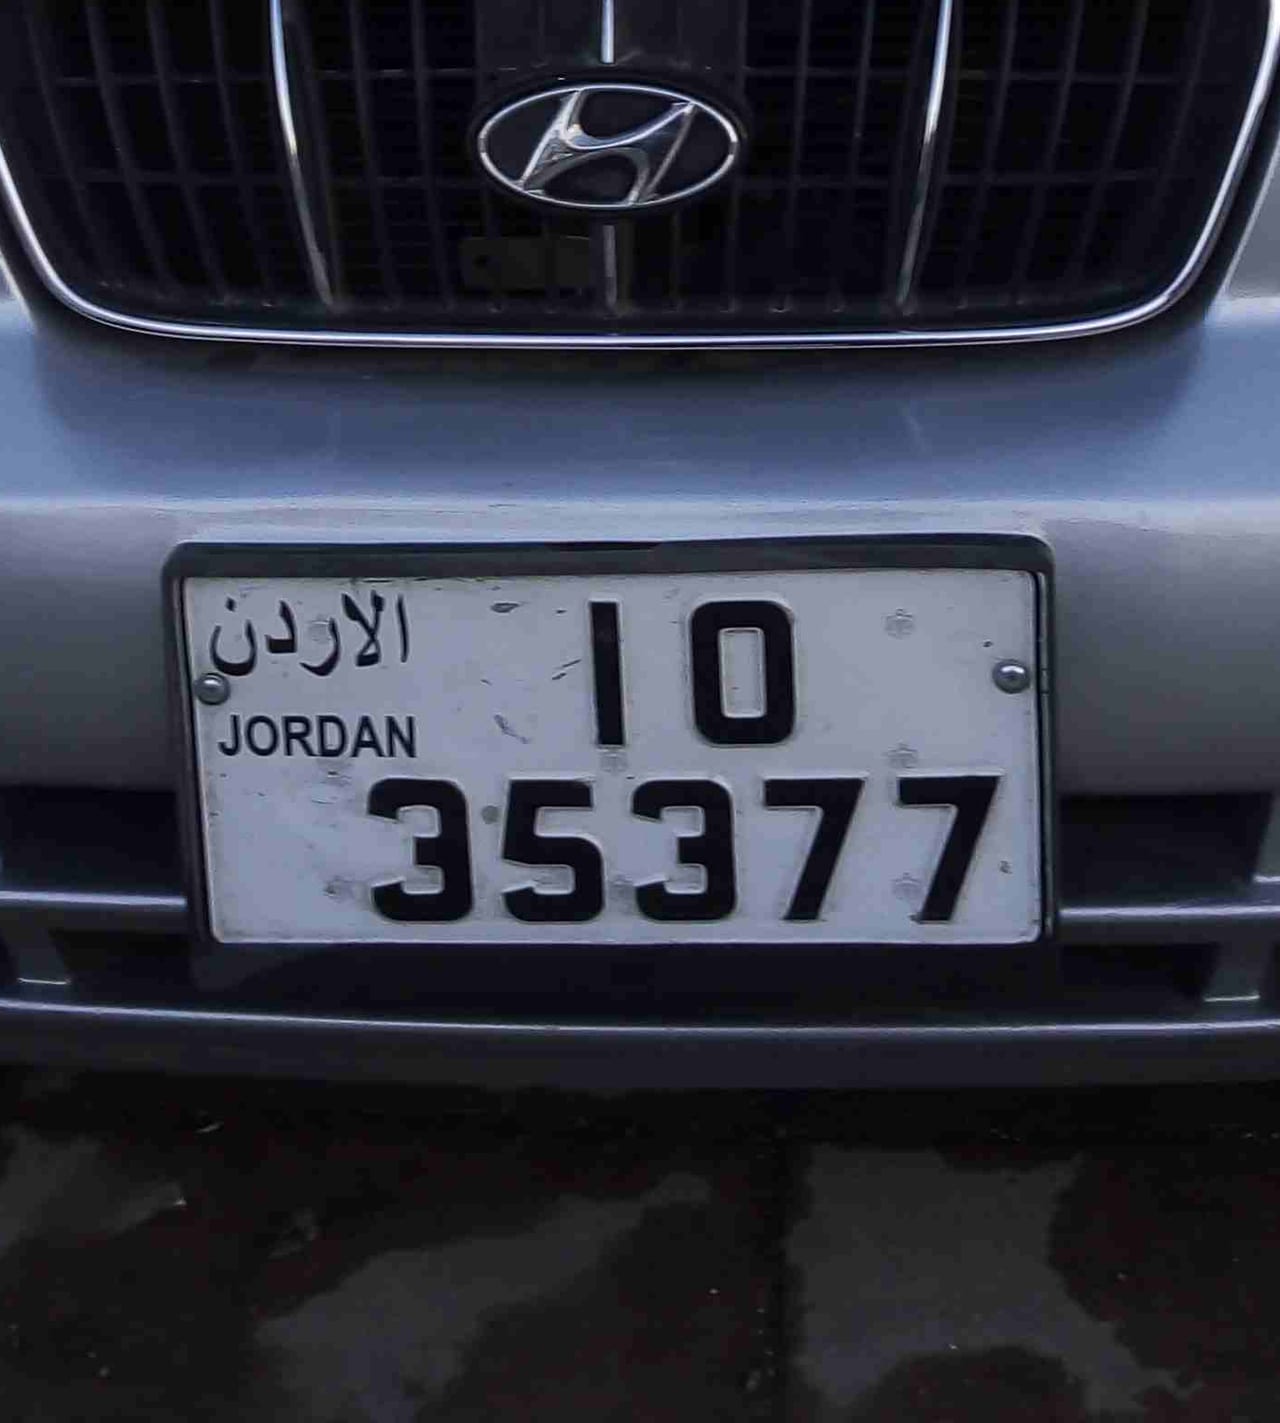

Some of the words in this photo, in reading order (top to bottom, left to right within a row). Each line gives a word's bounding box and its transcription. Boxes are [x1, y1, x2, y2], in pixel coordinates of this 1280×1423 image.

[218, 713, 417, 758] JORDAN
[588, 599, 796, 749] 10
[366, 776, 1001, 923] 35377
